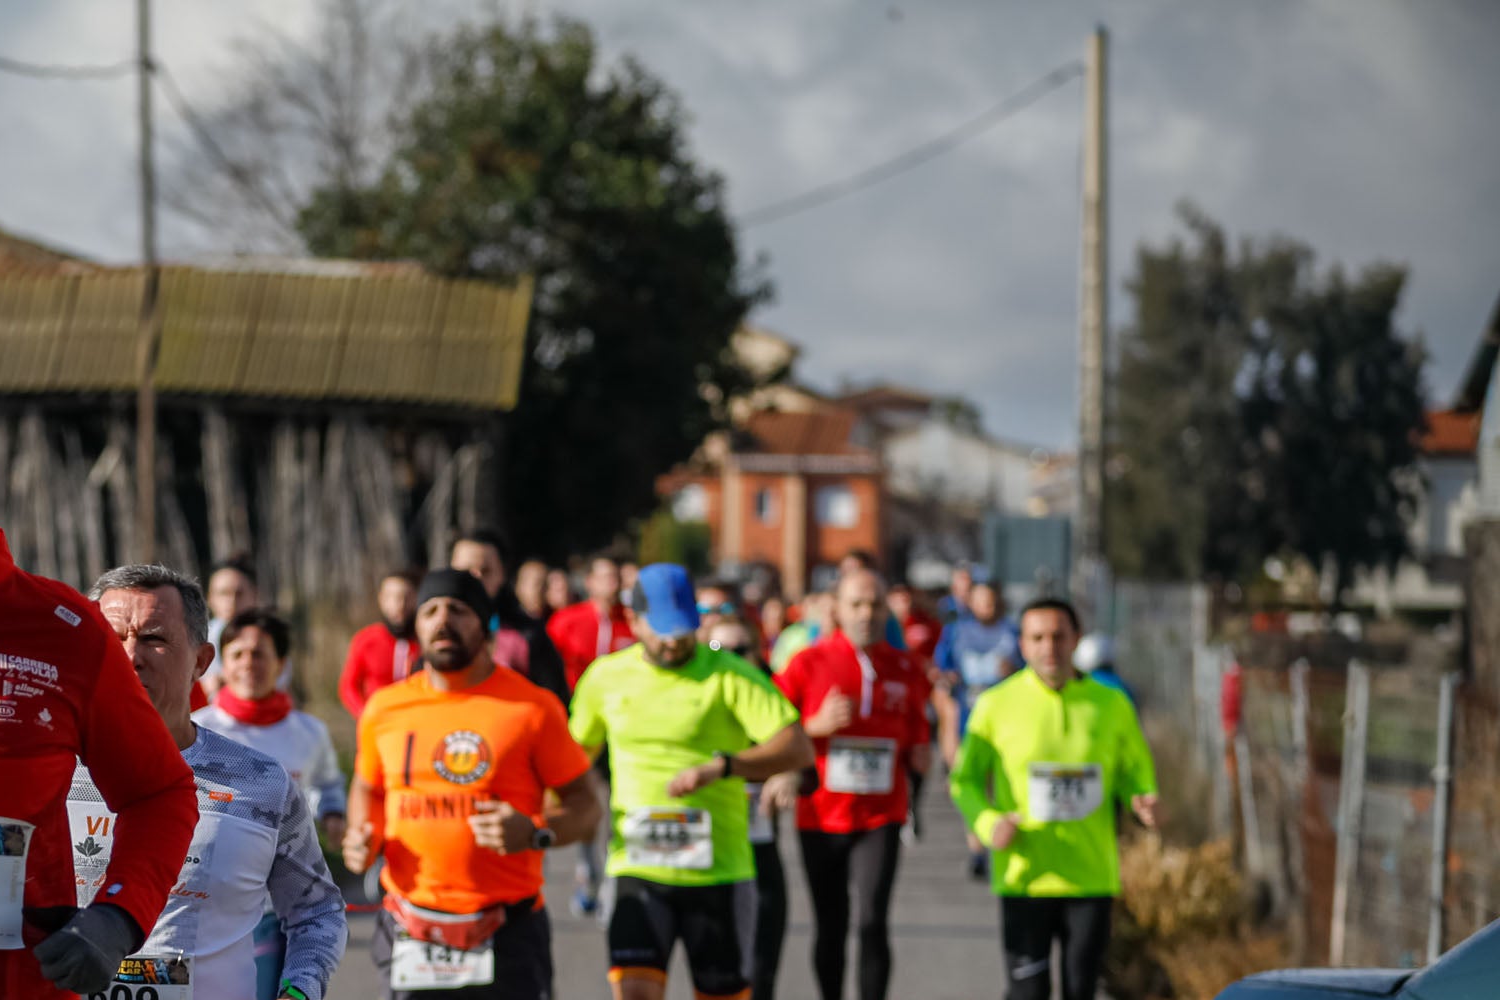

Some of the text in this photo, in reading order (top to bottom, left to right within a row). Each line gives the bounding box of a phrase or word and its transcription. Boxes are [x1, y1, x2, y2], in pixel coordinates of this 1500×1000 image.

[8, 655, 57, 672] CARRERA
[8, 663, 59, 681] POPULAR
[87, 815, 110, 837] VI
